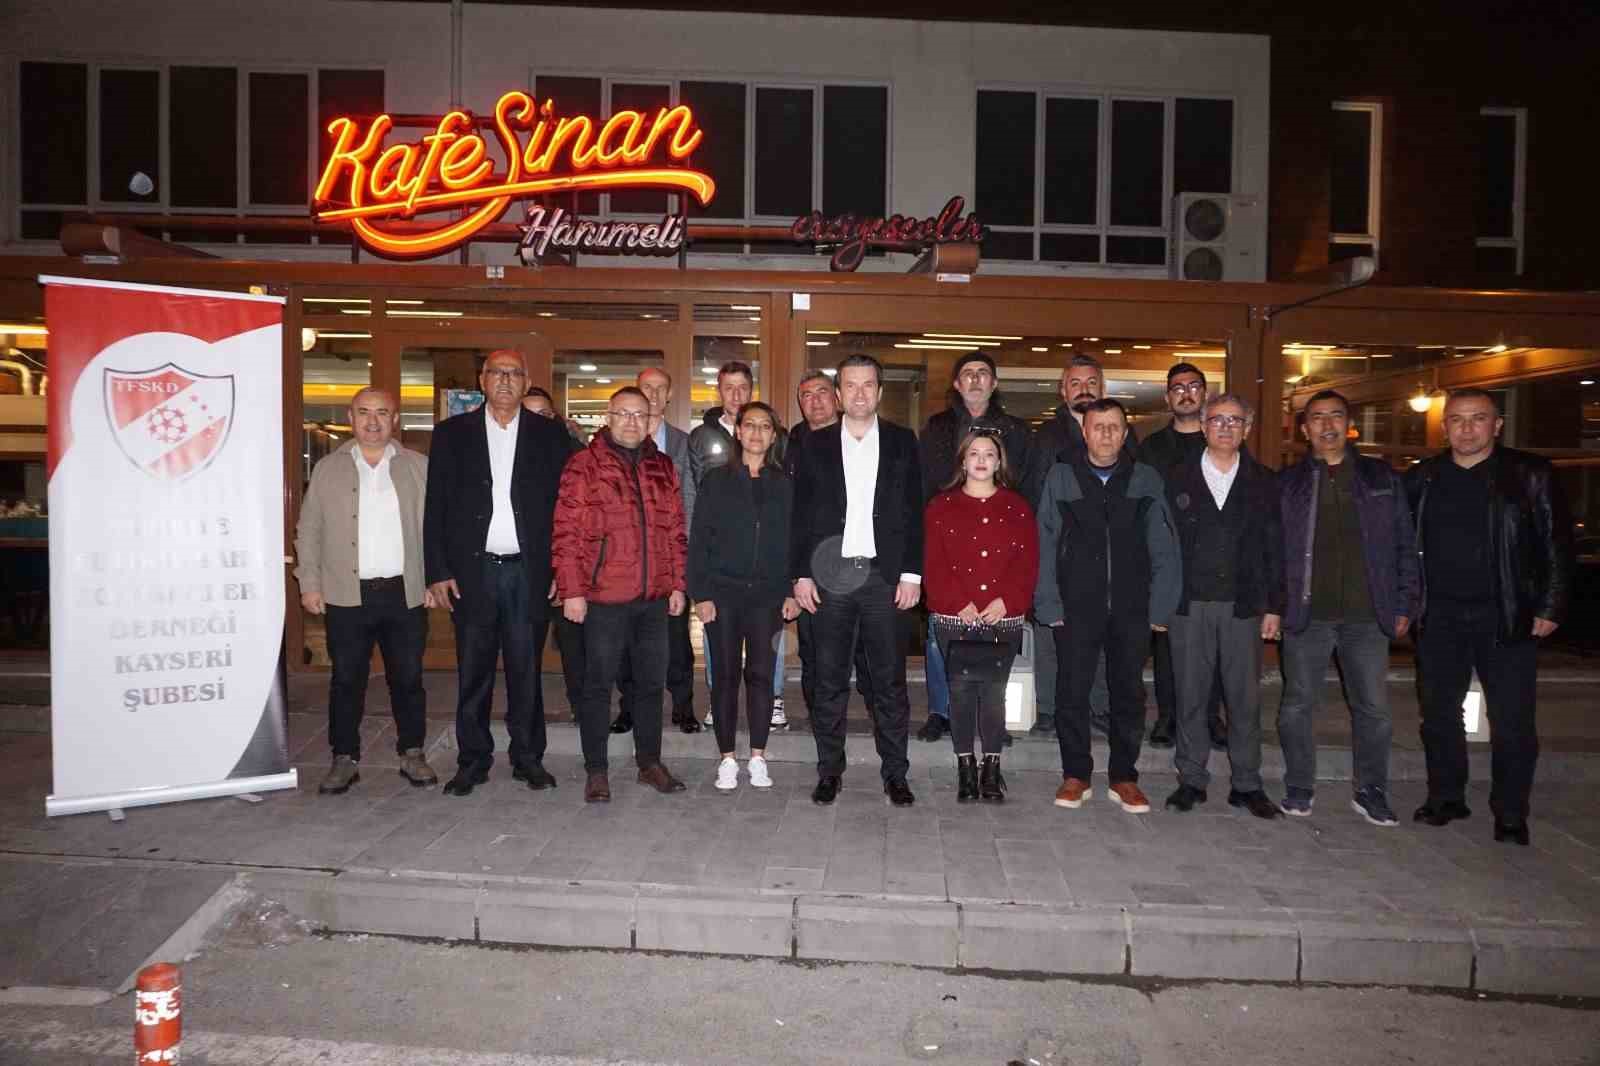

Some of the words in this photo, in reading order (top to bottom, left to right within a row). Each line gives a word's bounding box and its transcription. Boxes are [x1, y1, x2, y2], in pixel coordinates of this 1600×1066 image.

[312, 110, 498, 238] Kafe
[495, 89, 706, 190] Sinan
[115, 380, 179, 394] TFSKD
[110, 610, 237, 640] DERNEĞİ
[115, 643, 233, 675] KAYSERİ
[123, 677, 226, 713] ŞUBESİ
